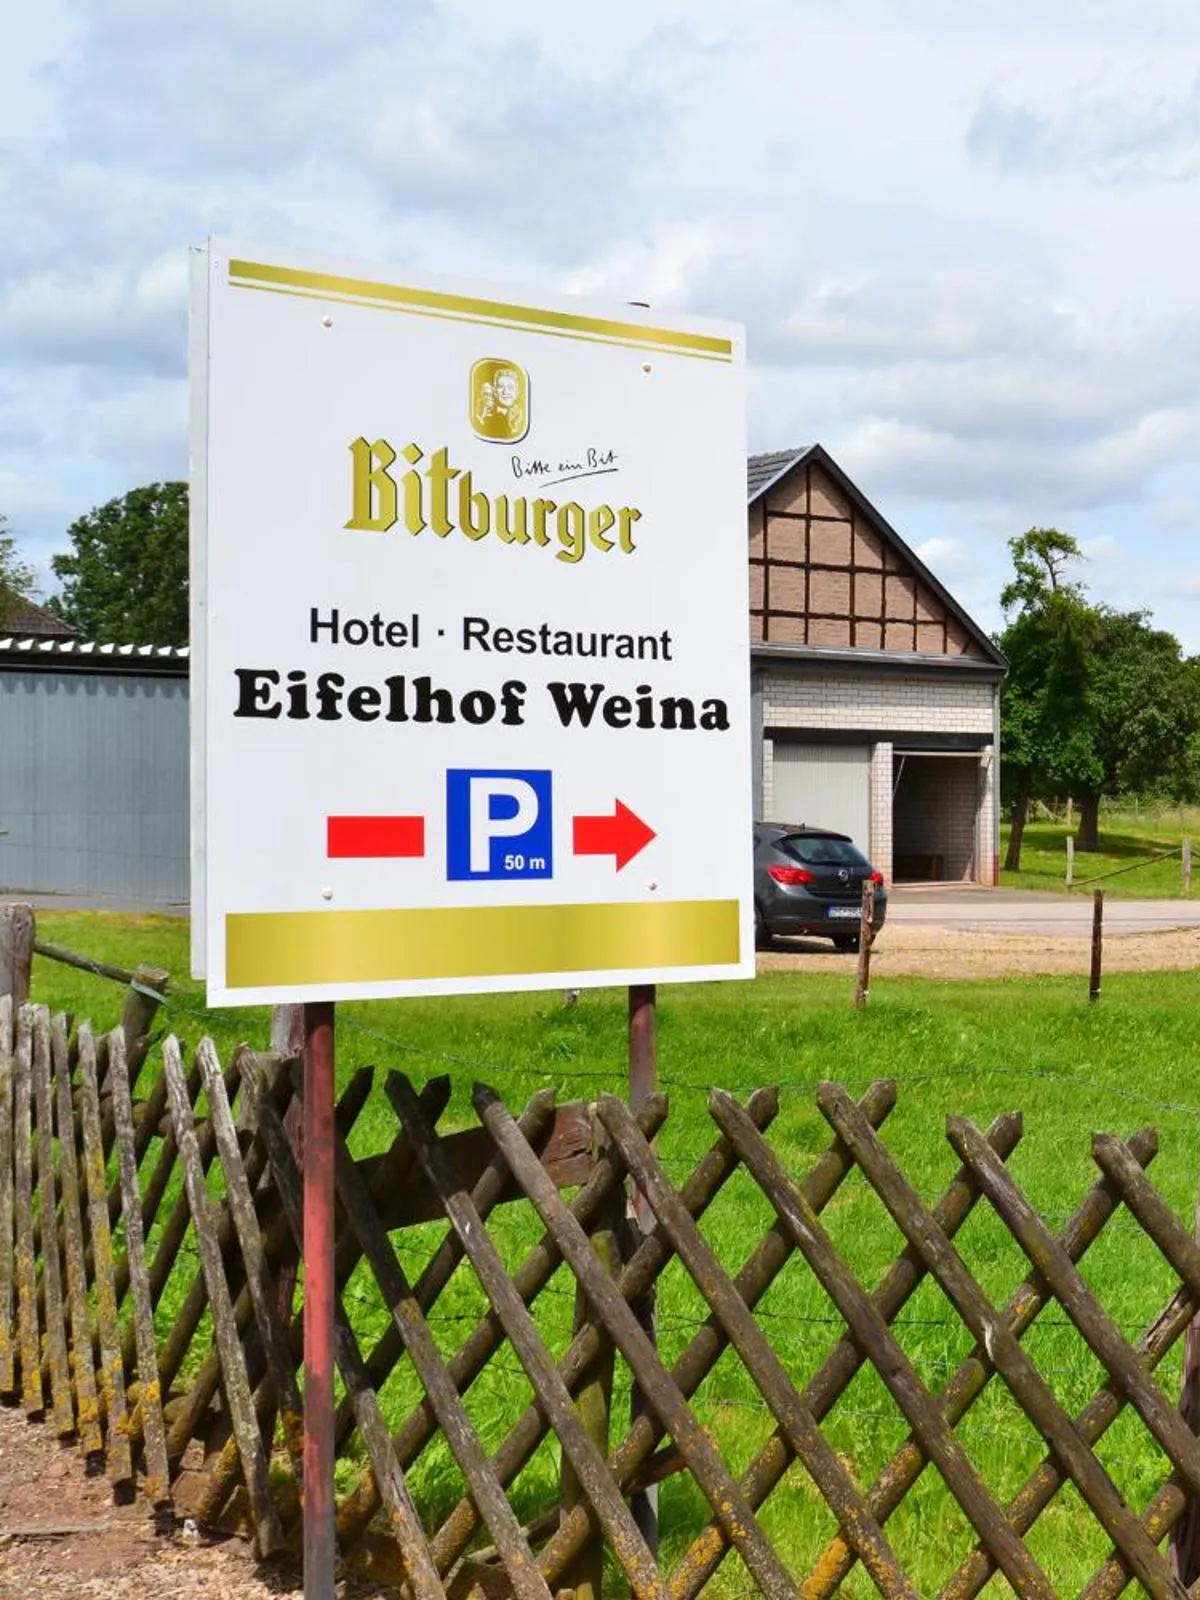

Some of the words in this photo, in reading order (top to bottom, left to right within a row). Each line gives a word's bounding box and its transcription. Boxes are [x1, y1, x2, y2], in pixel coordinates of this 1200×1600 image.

[511, 455, 551, 479] Bitte
[558, 460, 583, 472] ein
[586, 447, 619, 468] Bit
[342, 436, 643, 564] Bitburger
[309, 607, 420, 649] Hotel
[463, 616, 673, 662] Restaurant
[232, 668, 528, 726] Eifelhof
[546, 681, 731, 732] Weina
[469, 777, 539, 873] P
[504, 854, 525, 871] 50
[529, 857, 545, 870] m
